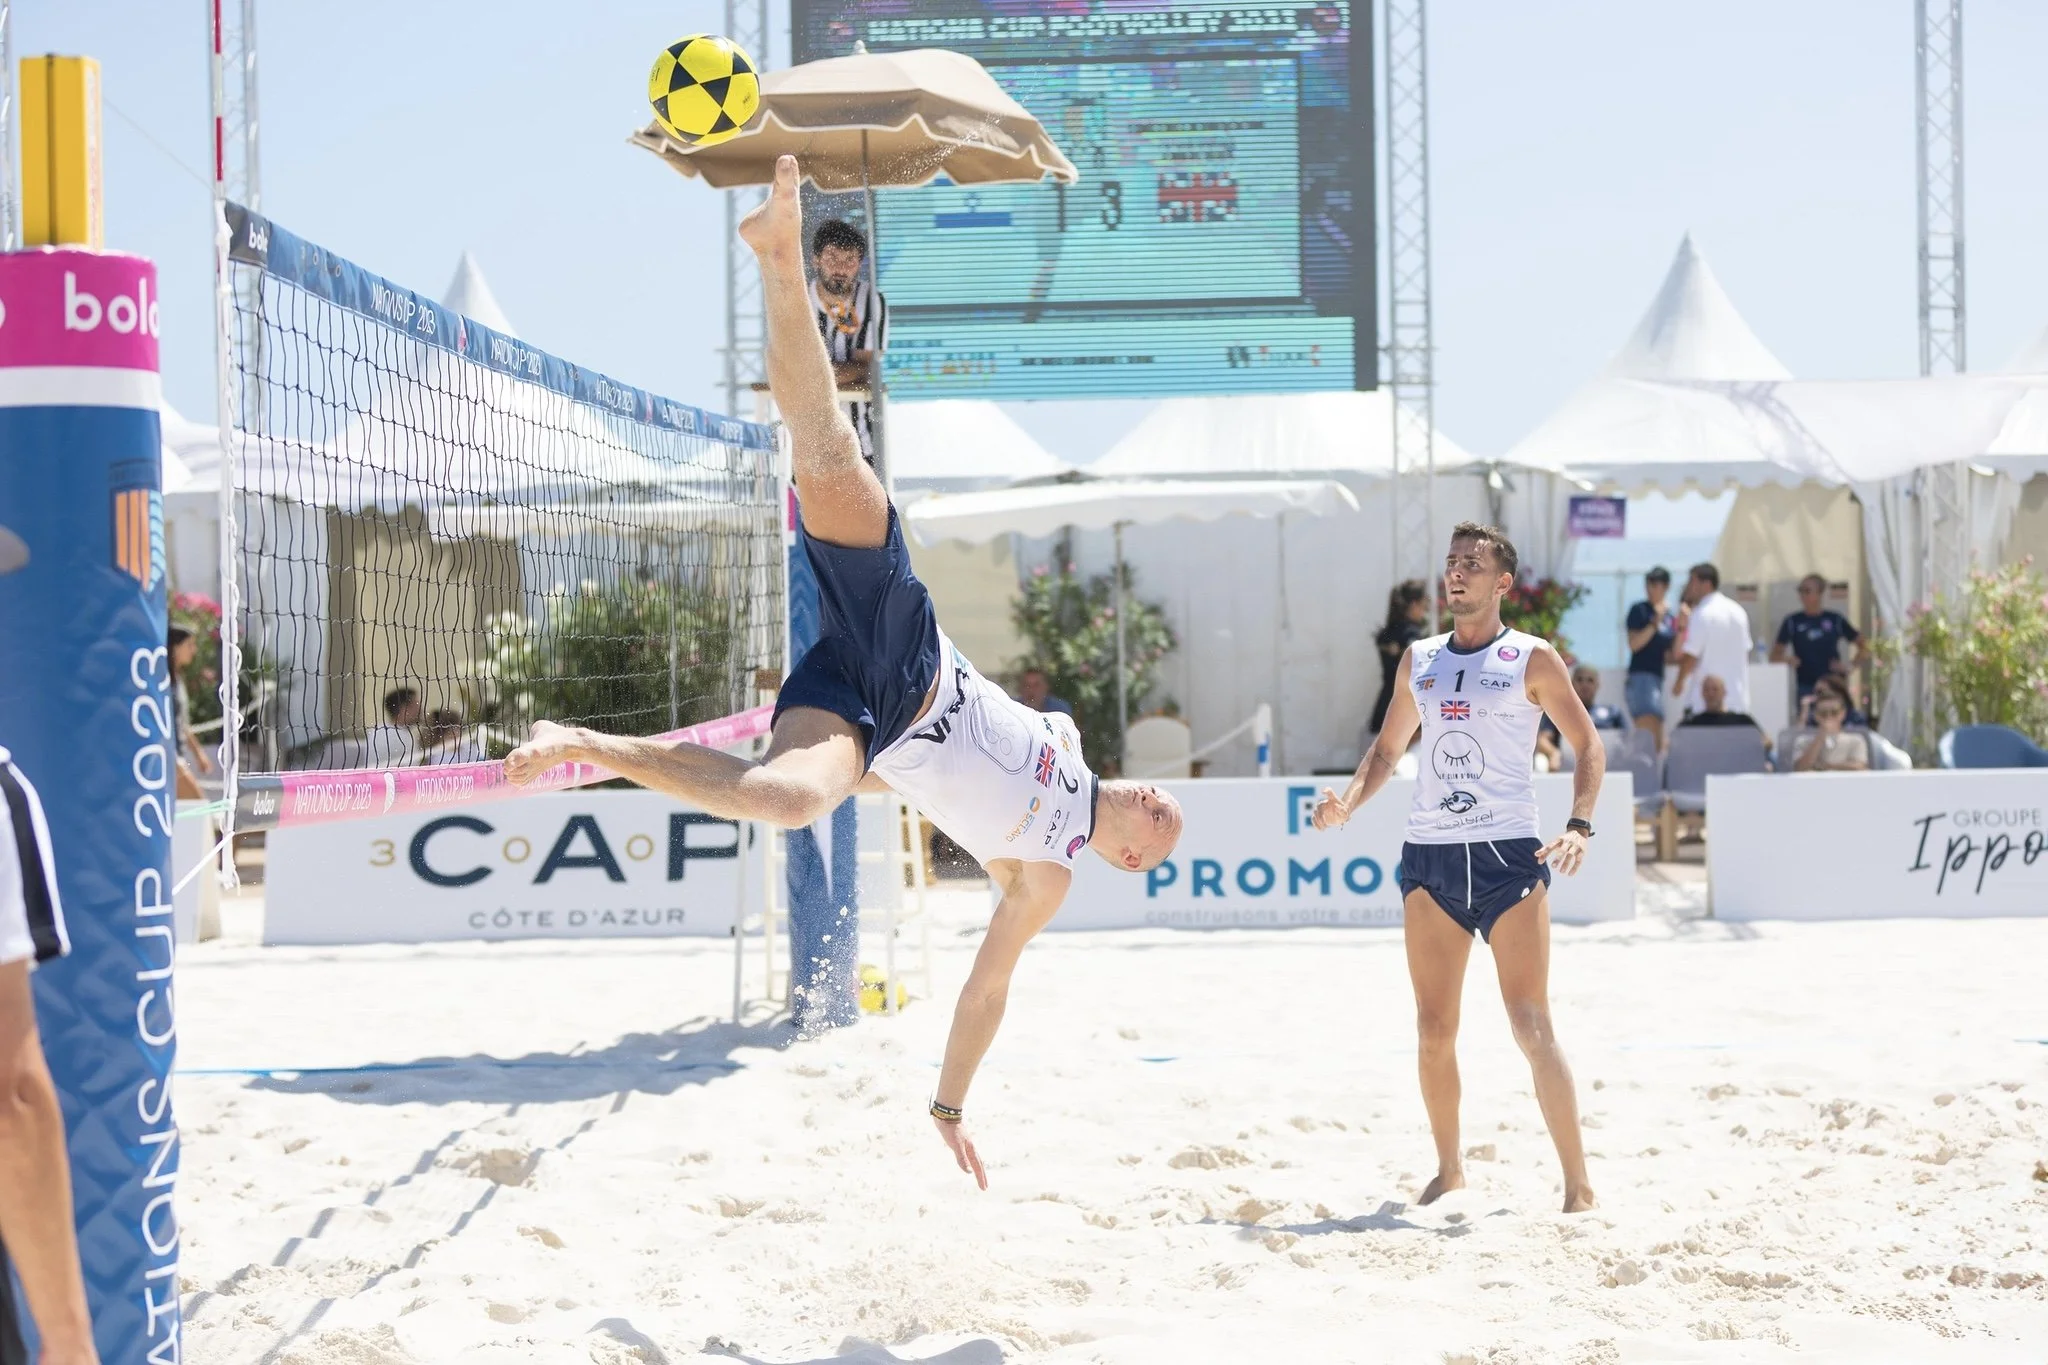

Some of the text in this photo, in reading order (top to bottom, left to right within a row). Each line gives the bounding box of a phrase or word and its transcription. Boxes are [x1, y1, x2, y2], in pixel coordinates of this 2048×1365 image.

[1102, 181, 1121, 231] 3
[1454, 669, 1466, 693] 1
[1480, 679, 1511, 688] CAP
[130, 646, 172, 838] 2023
[1057, 767, 1078, 794] 2
[293, 782, 372, 815] NATIONS CUP 2023
[1045, 809, 1062, 845] CAP
[1952, 808, 2041, 828] GROUPE
[1147, 857, 1403, 897] PROMO
[468, 907, 686, 929] CÔTE D'AZUR
[1288, 906, 1340, 922] votre
[135, 867, 176, 1047] CUP
